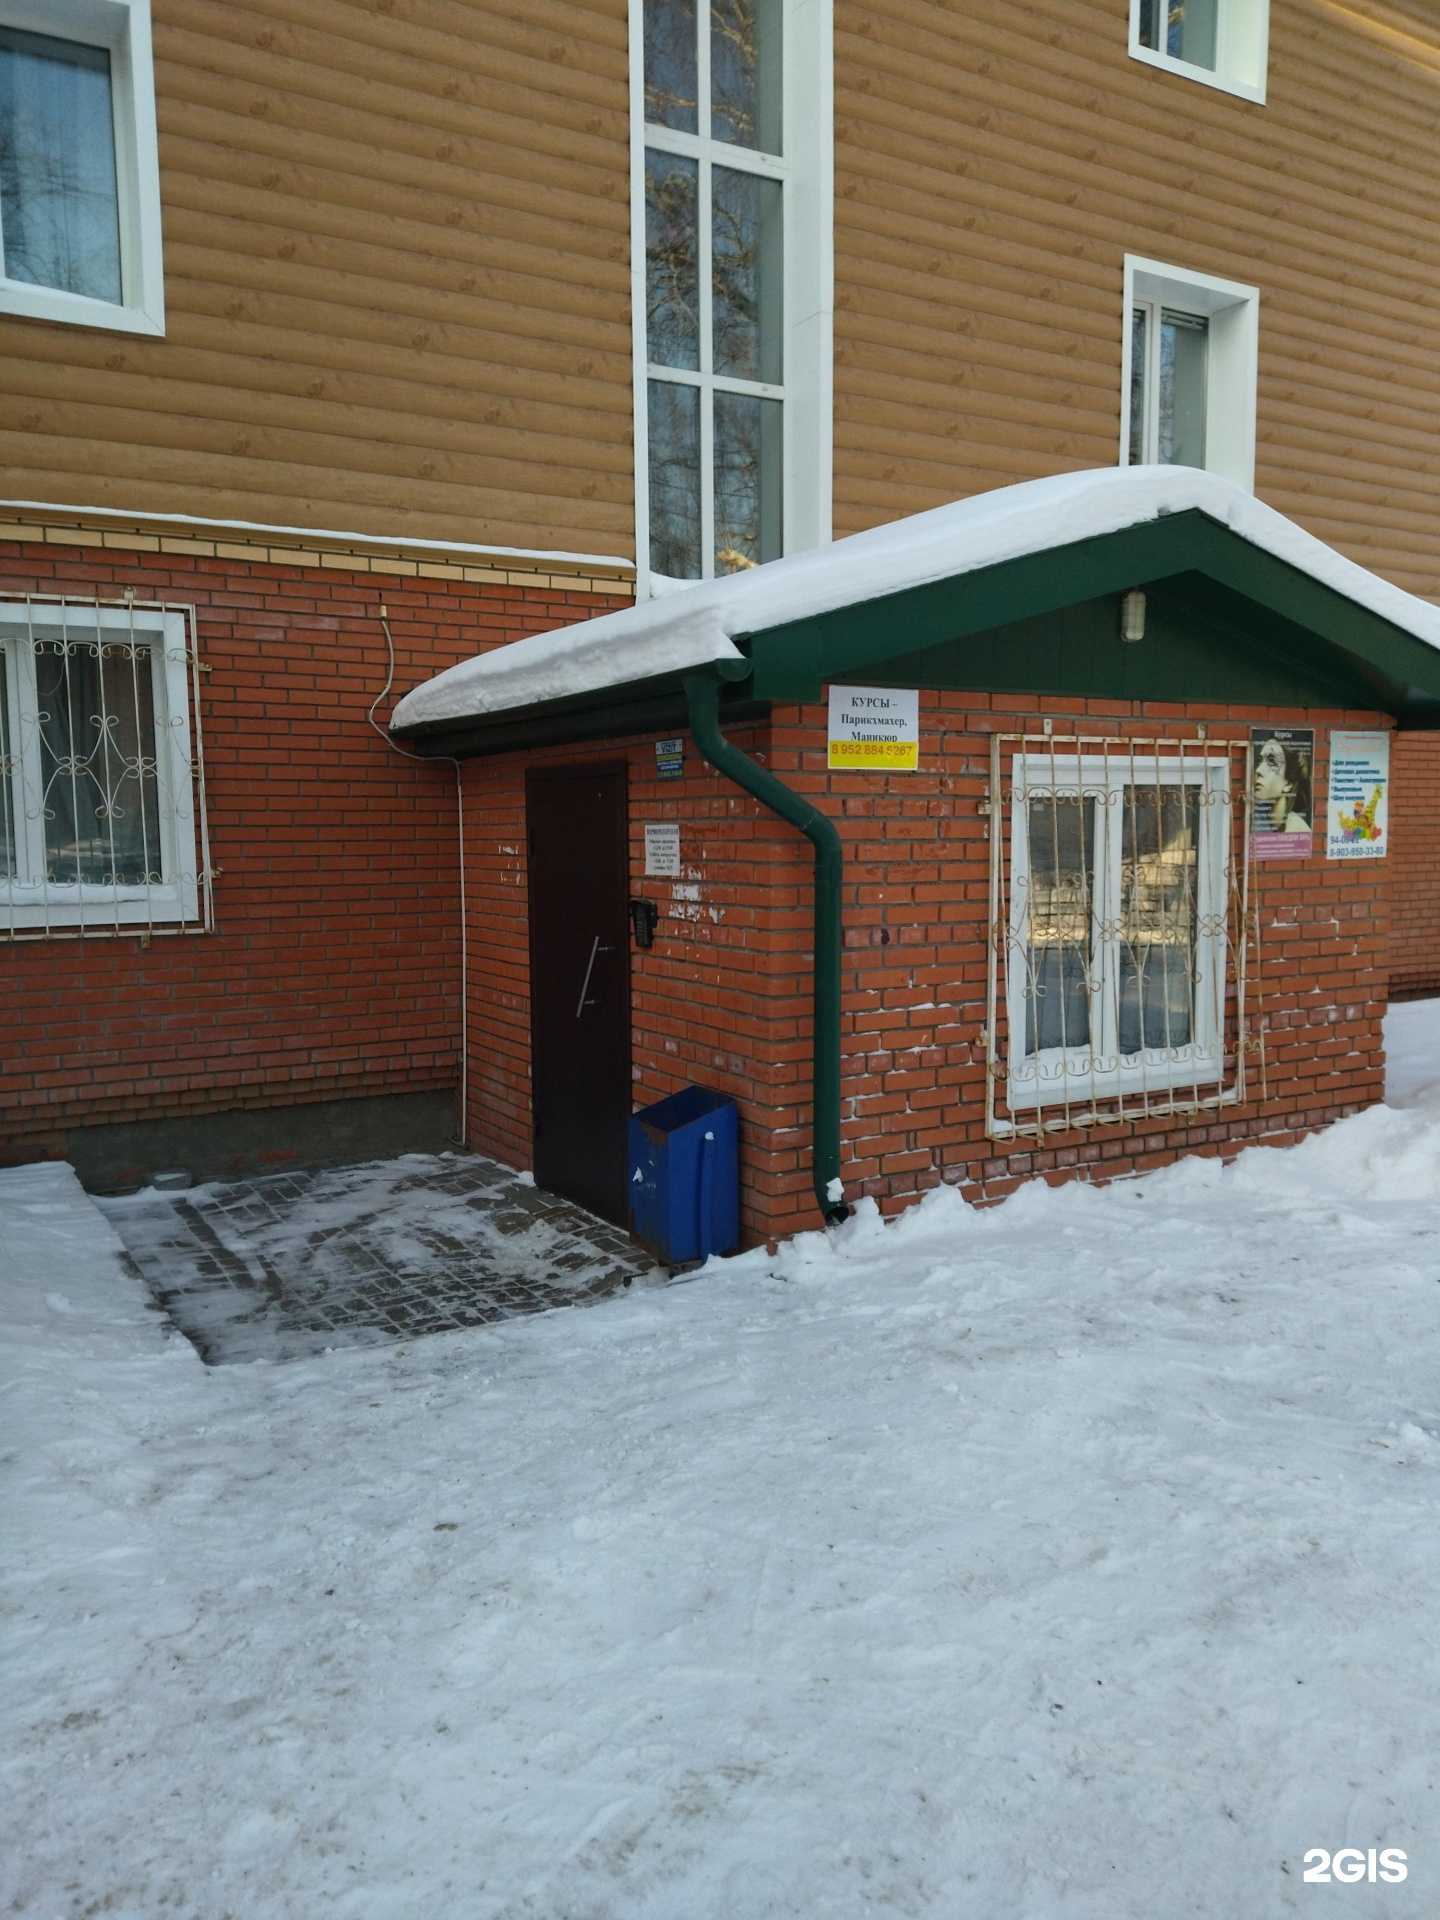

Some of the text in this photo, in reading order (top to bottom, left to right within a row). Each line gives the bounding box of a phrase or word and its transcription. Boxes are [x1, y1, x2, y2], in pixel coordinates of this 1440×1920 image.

[851, 696, 890, 708] КУРСЫ
[841, 713, 908, 728] Парикхмахер,
[851, 731, 898, 742] Маникюр
[832, 744, 839, 755] 8
[841, 744, 861, 755] 952
